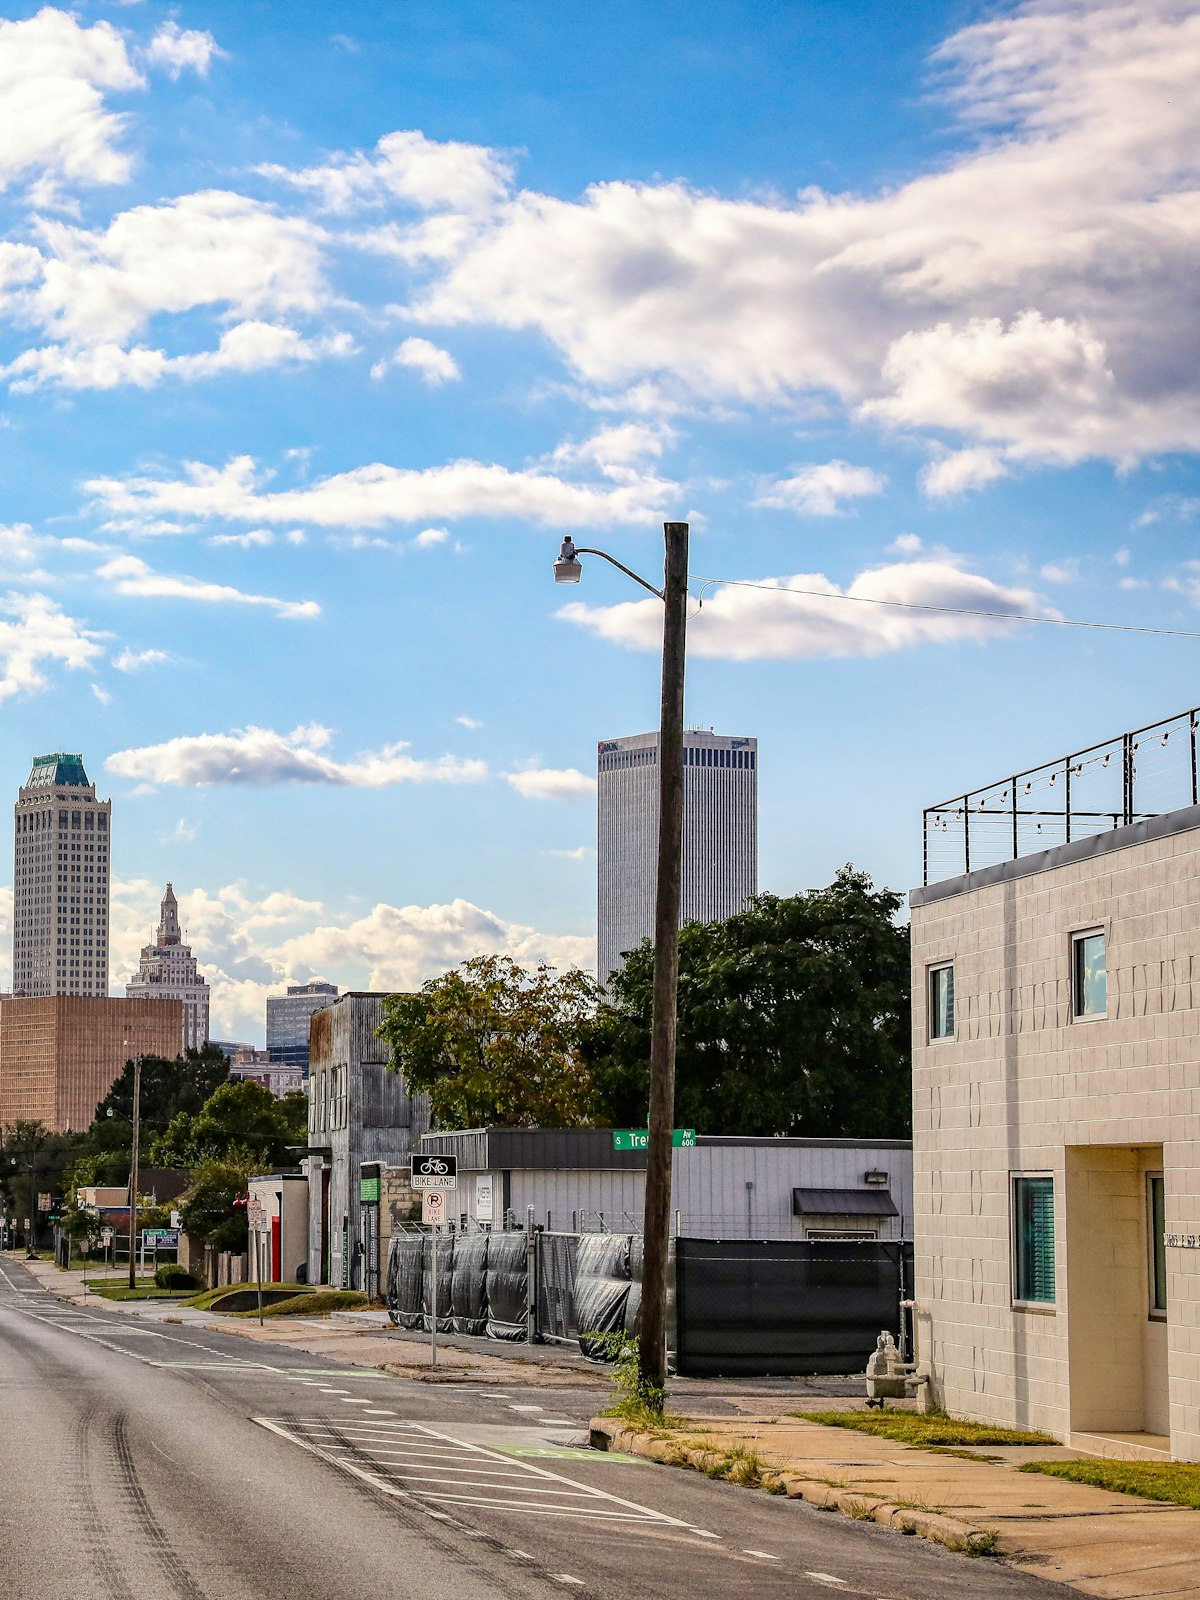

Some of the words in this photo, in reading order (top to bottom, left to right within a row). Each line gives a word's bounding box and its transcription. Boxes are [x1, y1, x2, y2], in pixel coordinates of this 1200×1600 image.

[616, 1136, 621, 1144] S
[629, 1133, 649, 1147] Tre
[683, 1130, 692, 1139] Av
[682, 1139, 694, 1147] 600
[415, 1177, 431, 1186] BIKE
[434, 1177, 454, 1186] LANE
